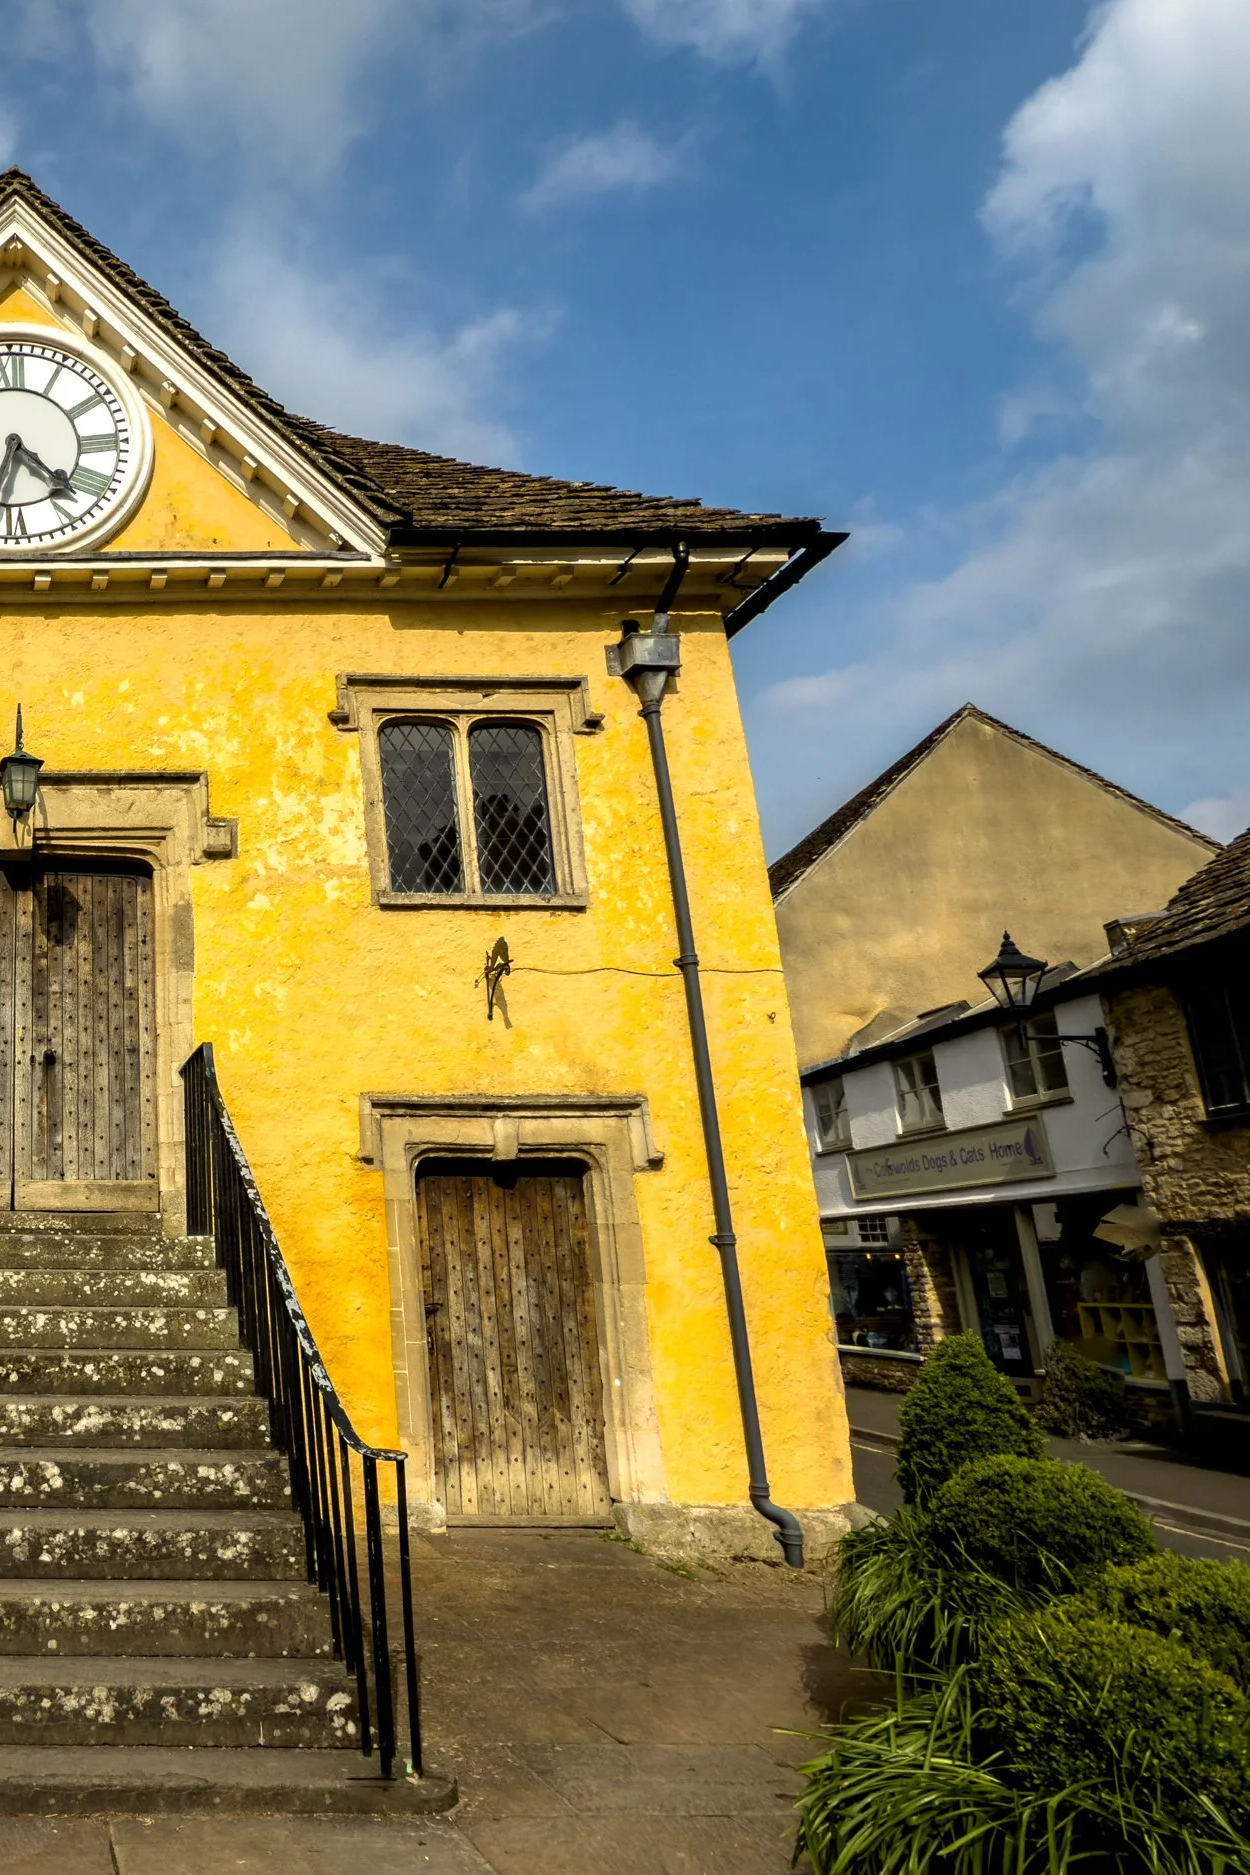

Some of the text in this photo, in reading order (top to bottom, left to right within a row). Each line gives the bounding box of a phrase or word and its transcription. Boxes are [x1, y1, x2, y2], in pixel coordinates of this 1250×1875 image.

[43, 365, 63, 395] I
[68, 393, 104, 419] II
[81, 433, 118, 454] III
[50, 499, 76, 525] V
[873, 1158, 921, 1178] Cotswolds
[922, 1154, 948, 1174] Dogs
[949, 1150, 957, 1166] &
[960, 1146, 985, 1164] Cats
[988, 1141, 1024, 1160] Home
